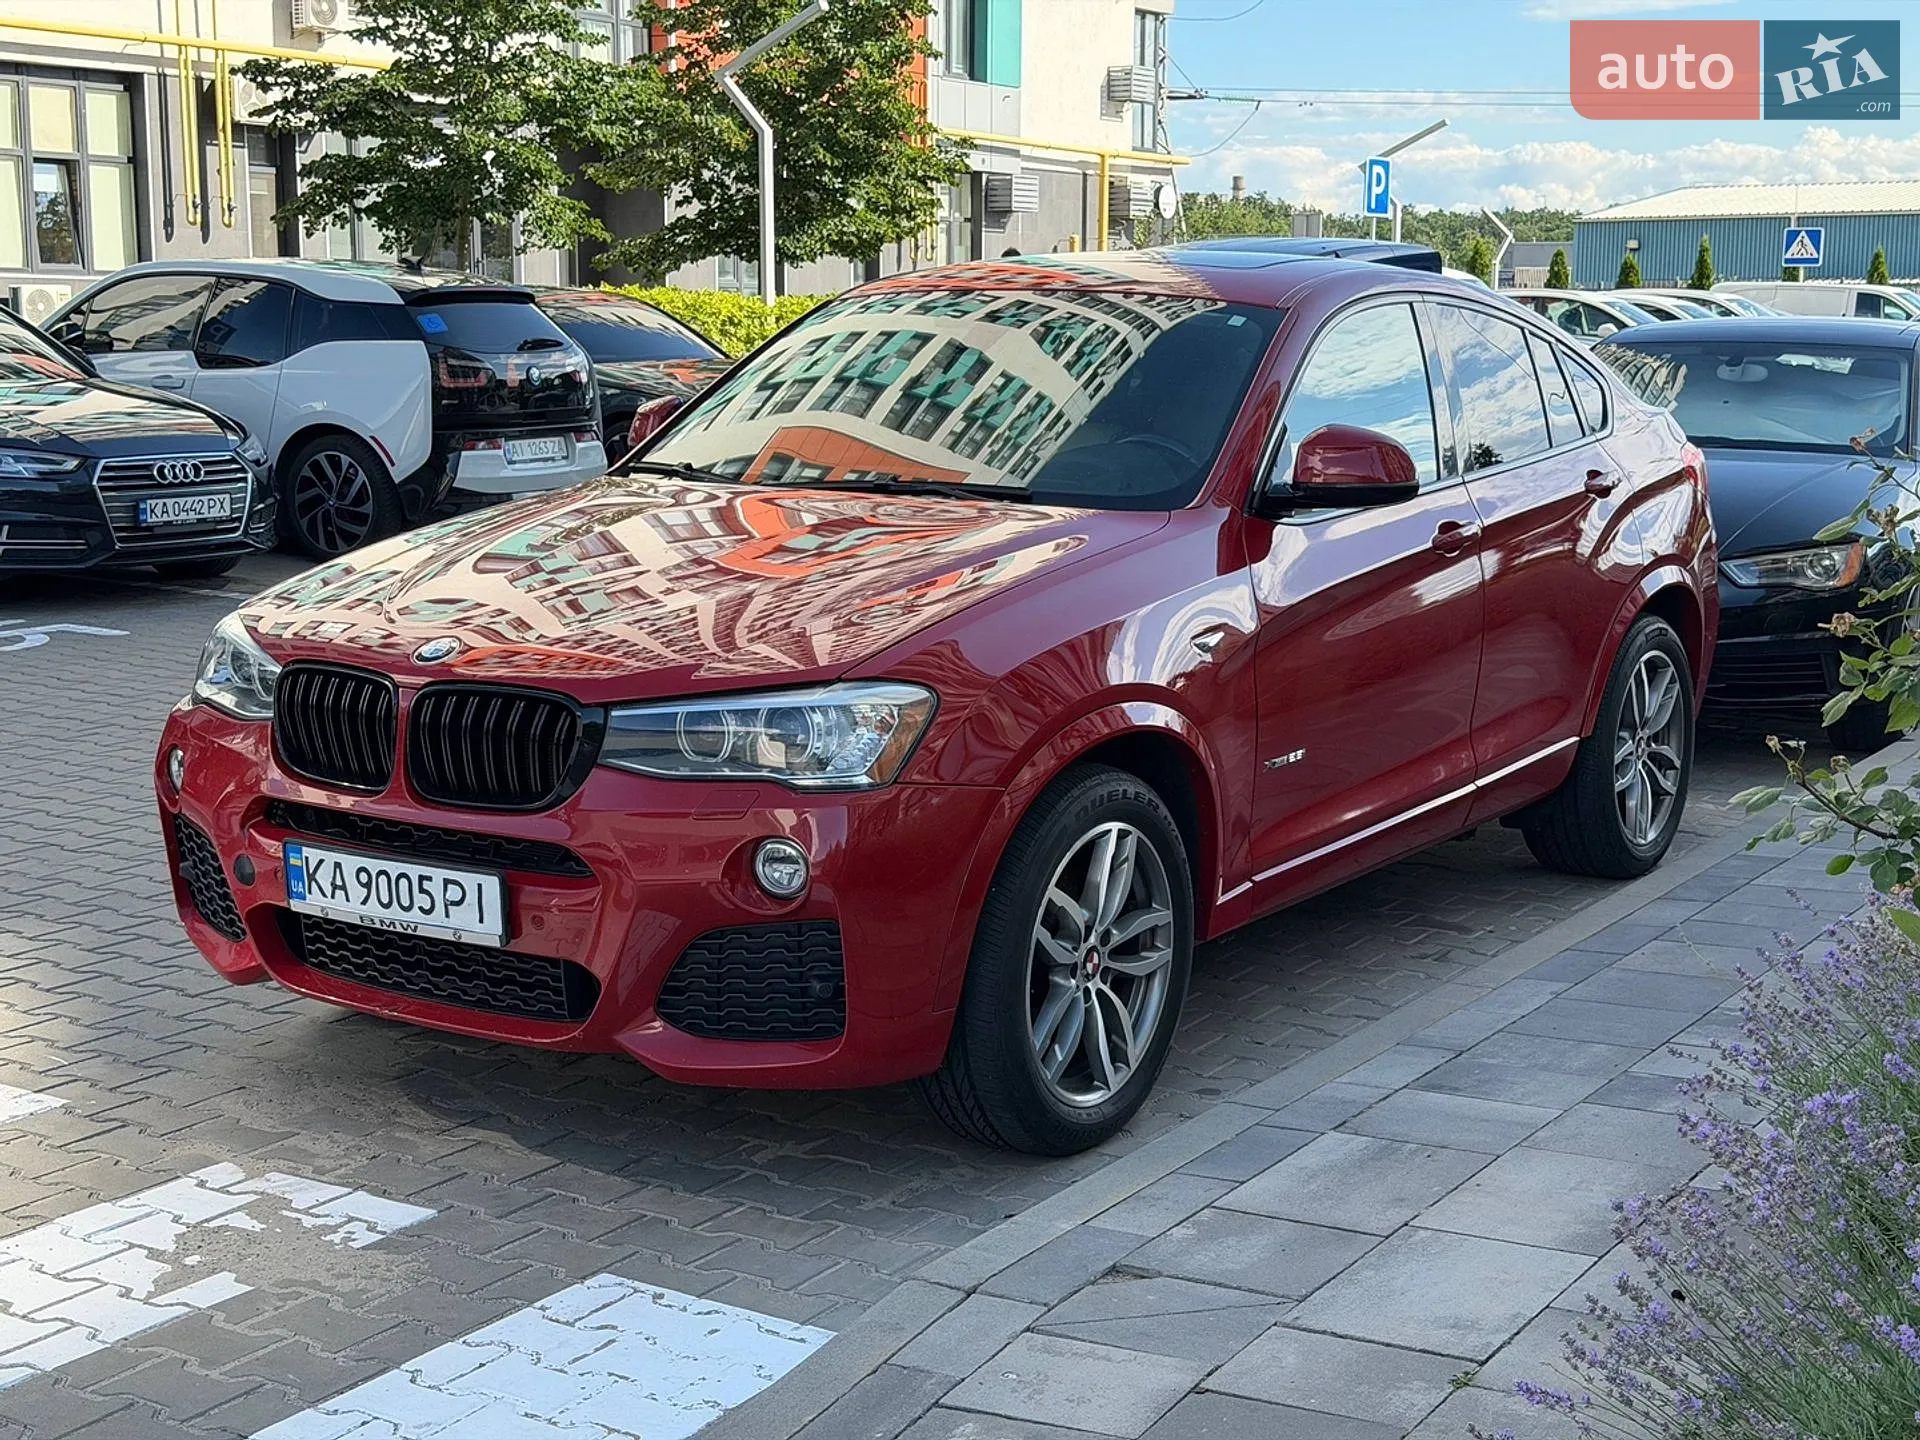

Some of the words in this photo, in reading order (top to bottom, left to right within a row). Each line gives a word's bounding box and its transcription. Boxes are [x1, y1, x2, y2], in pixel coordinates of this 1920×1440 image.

[1370, 164, 1386, 210] P
[290, 879, 305, 894] UA
[359, 915, 420, 934] BMW
